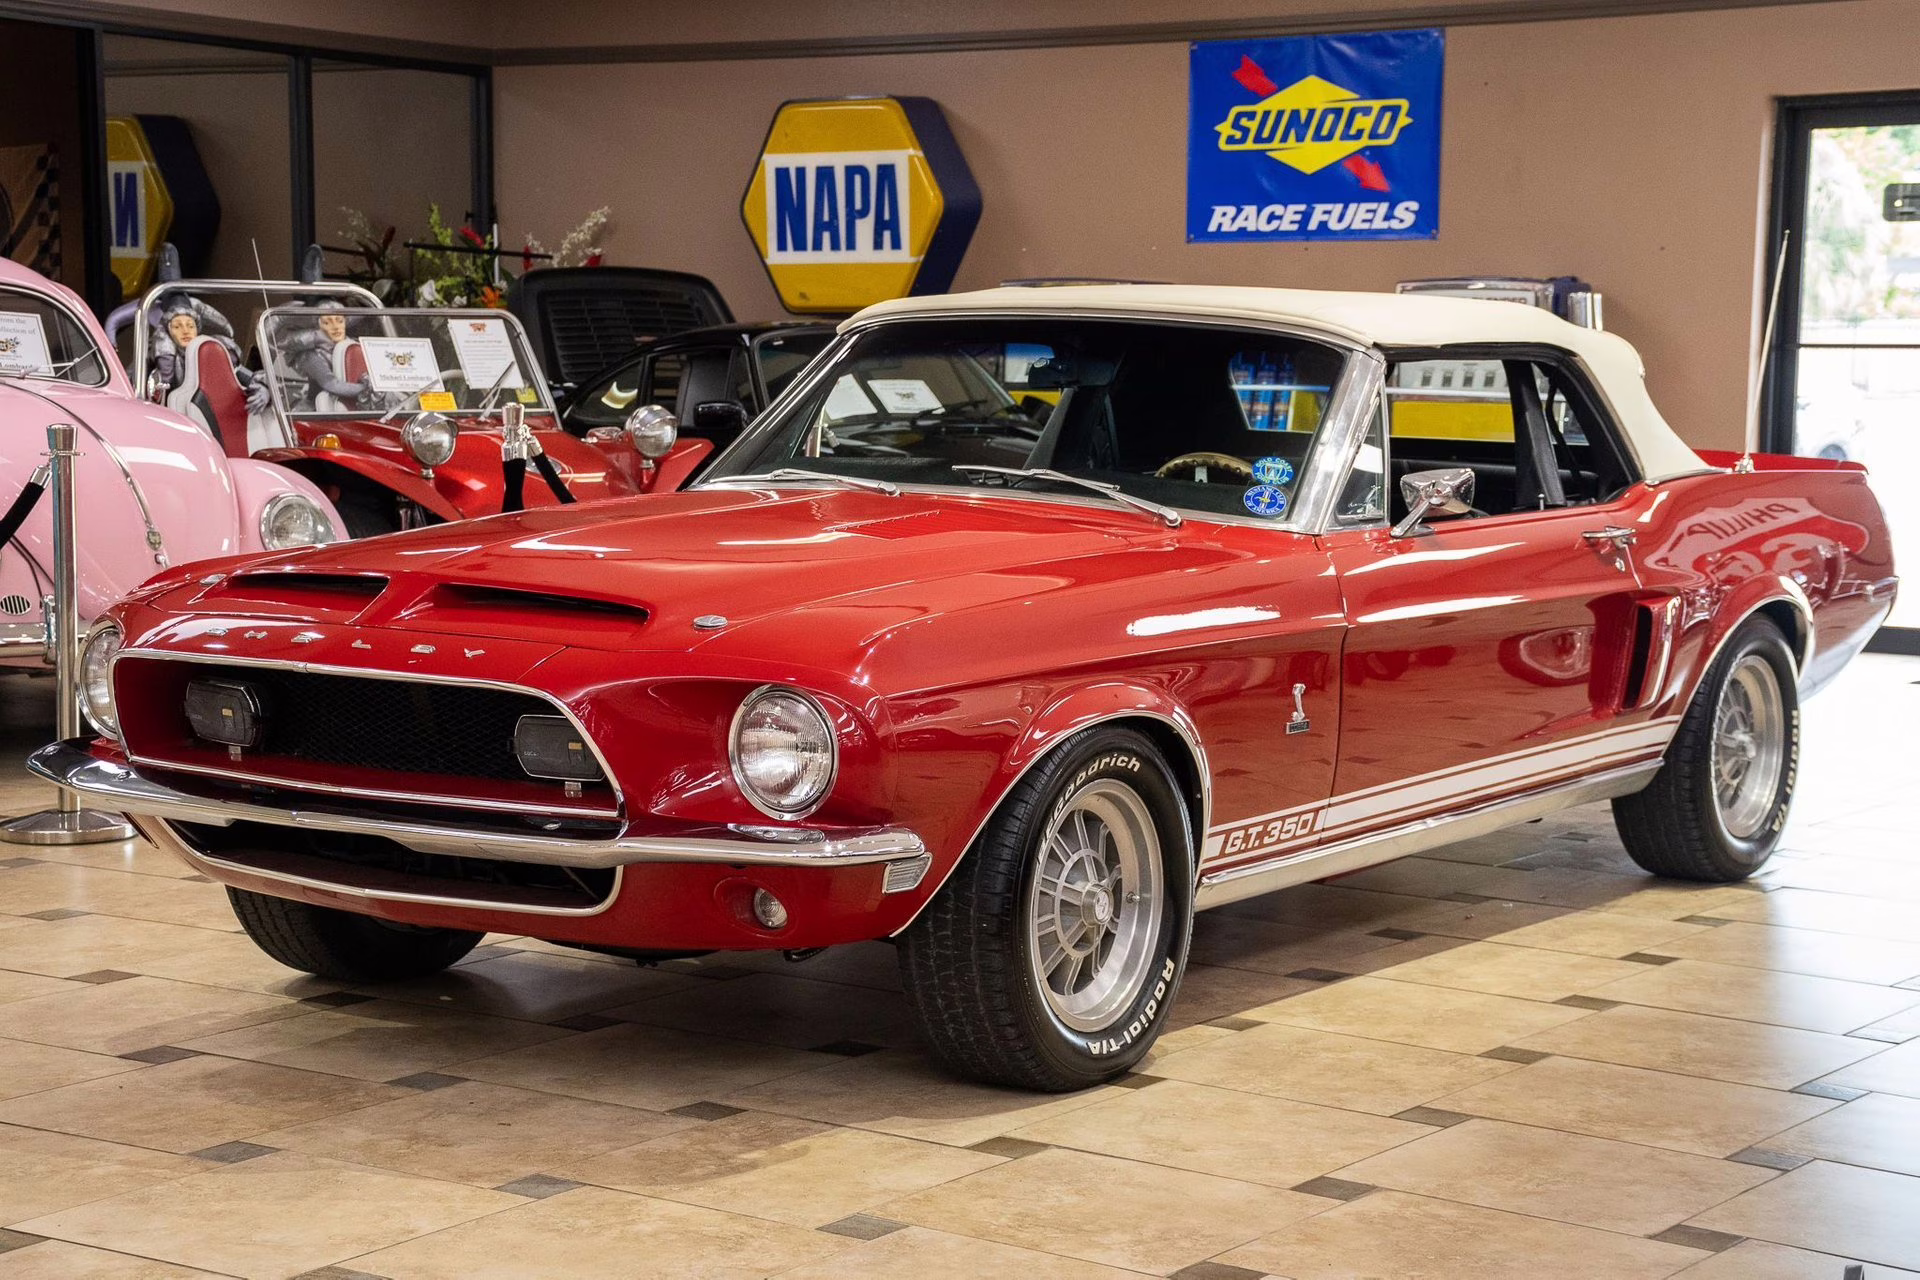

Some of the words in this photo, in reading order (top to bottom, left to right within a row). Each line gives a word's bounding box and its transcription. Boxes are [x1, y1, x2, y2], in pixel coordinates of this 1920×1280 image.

[1225, 105, 1402, 145] SUNOCO
[775, 164, 902, 252] NAPA
[1207, 204, 1306, 232] RACE
[1307, 201, 1420, 231] FUELS
[206, 627, 486, 658] SHELBY
[1123, 957, 1175, 1044] Radial
